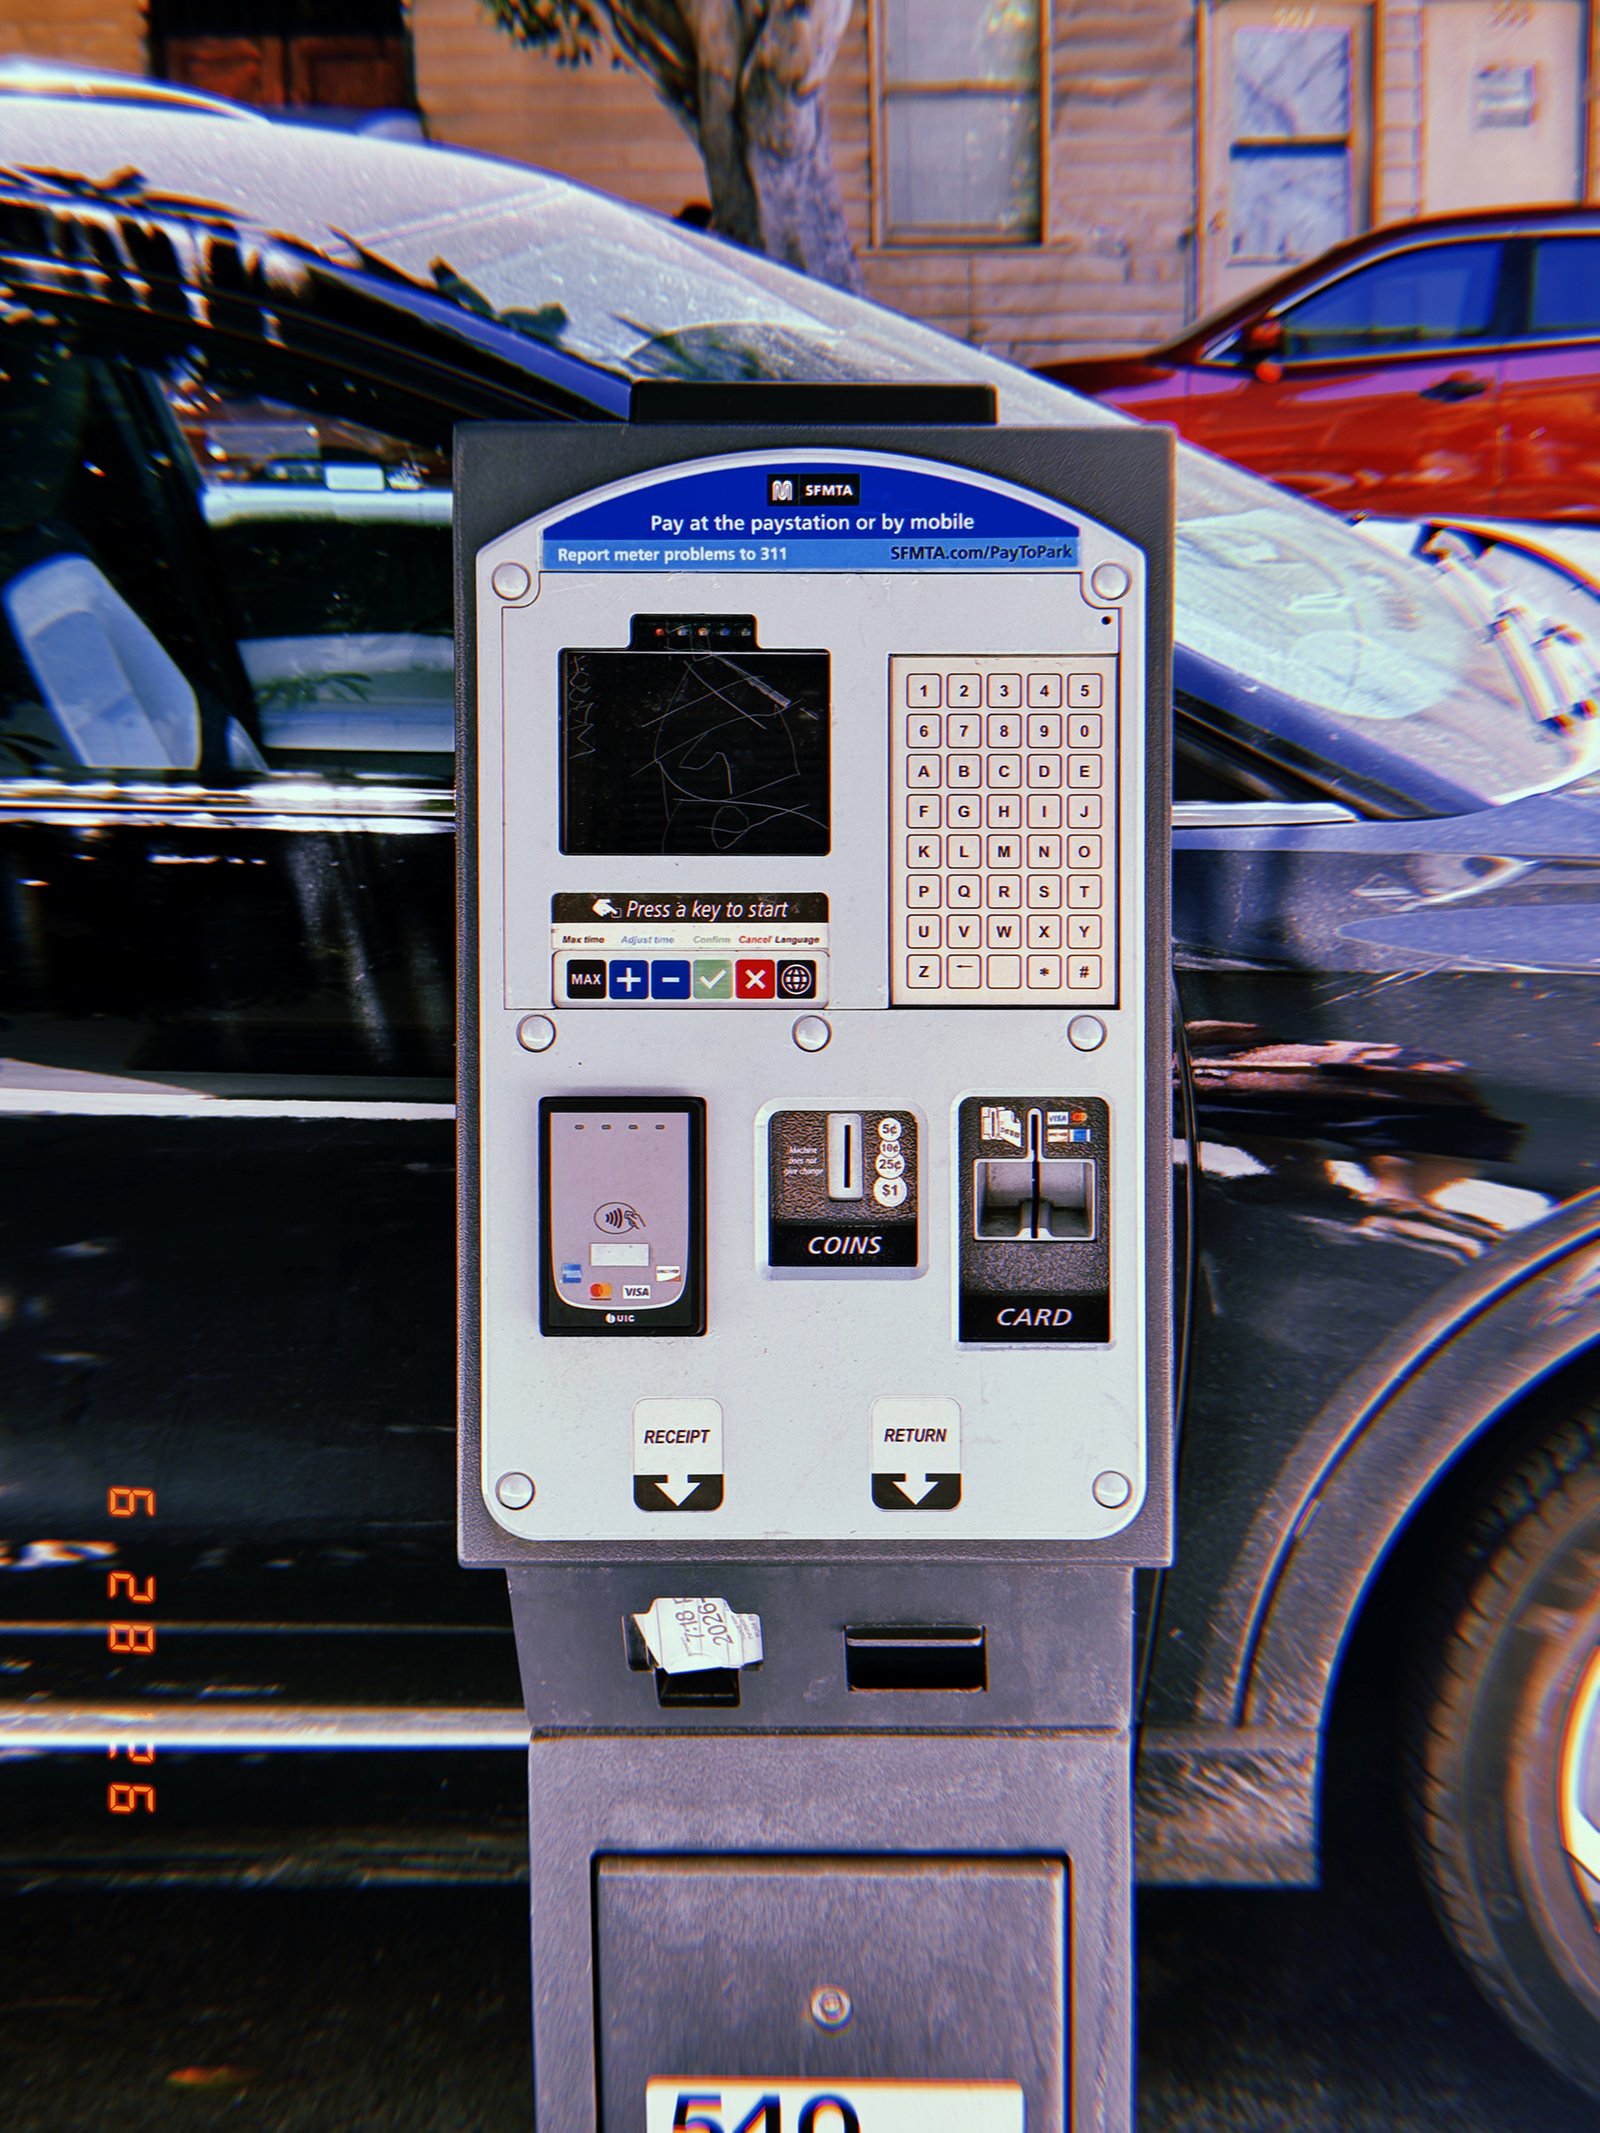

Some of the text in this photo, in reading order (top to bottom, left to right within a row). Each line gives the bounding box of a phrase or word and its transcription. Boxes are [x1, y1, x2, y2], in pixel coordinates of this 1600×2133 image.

[806, 485, 852, 496] SFMTA
[652, 513, 974, 535] Pay at the paystation or by mobile
[559, 547, 786, 564] Report meter problems to 311
[892, 544, 1071, 562] SFMTA.com/PayToPark
[920, 684, 1090, 698] 1 2 3 4 5
[920, 724, 929, 738] 6
[960, 724, 969, 738] 7
[1000, 724, 1009, 738] 8
[1040, 724, 1049, 738] 9
[918, 765, 1090, 778] A B C D E
[920, 805, 929, 818] F
[958, 805, 971, 818] G
[999, 805, 1010, 818] H
[1080, 805, 1089, 818] J
[919, 845, 930, 858] K
[960, 845, 970, 858] L
[998, 845, 1011, 858] M
[1039, 845, 1050, 858] N
[919, 884, 1090, 898] P Q R S T
[626, 900, 788, 922] Press a key to start
[919, 925, 1090, 938] U V W X Y
[621, 936, 652, 945] Adjust
[775, 936, 820, 945] Language
[919, 965, 930, 978] Z
[1080, 965, 1089, 978] #
[572, 974, 600, 985] MAX
[879, 1159, 902, 1170] 25¢
[882, 1184, 898, 1197] $1
[808, 1236, 882, 1254] COINS
[625, 1288, 649, 1297] VISA
[617, 1314, 635, 1322] UIC
[997, 1308, 1073, 1326] CARD
[644, 1429, 710, 1444] RECEIPT
[884, 1428, 947, 1443] RETURN
